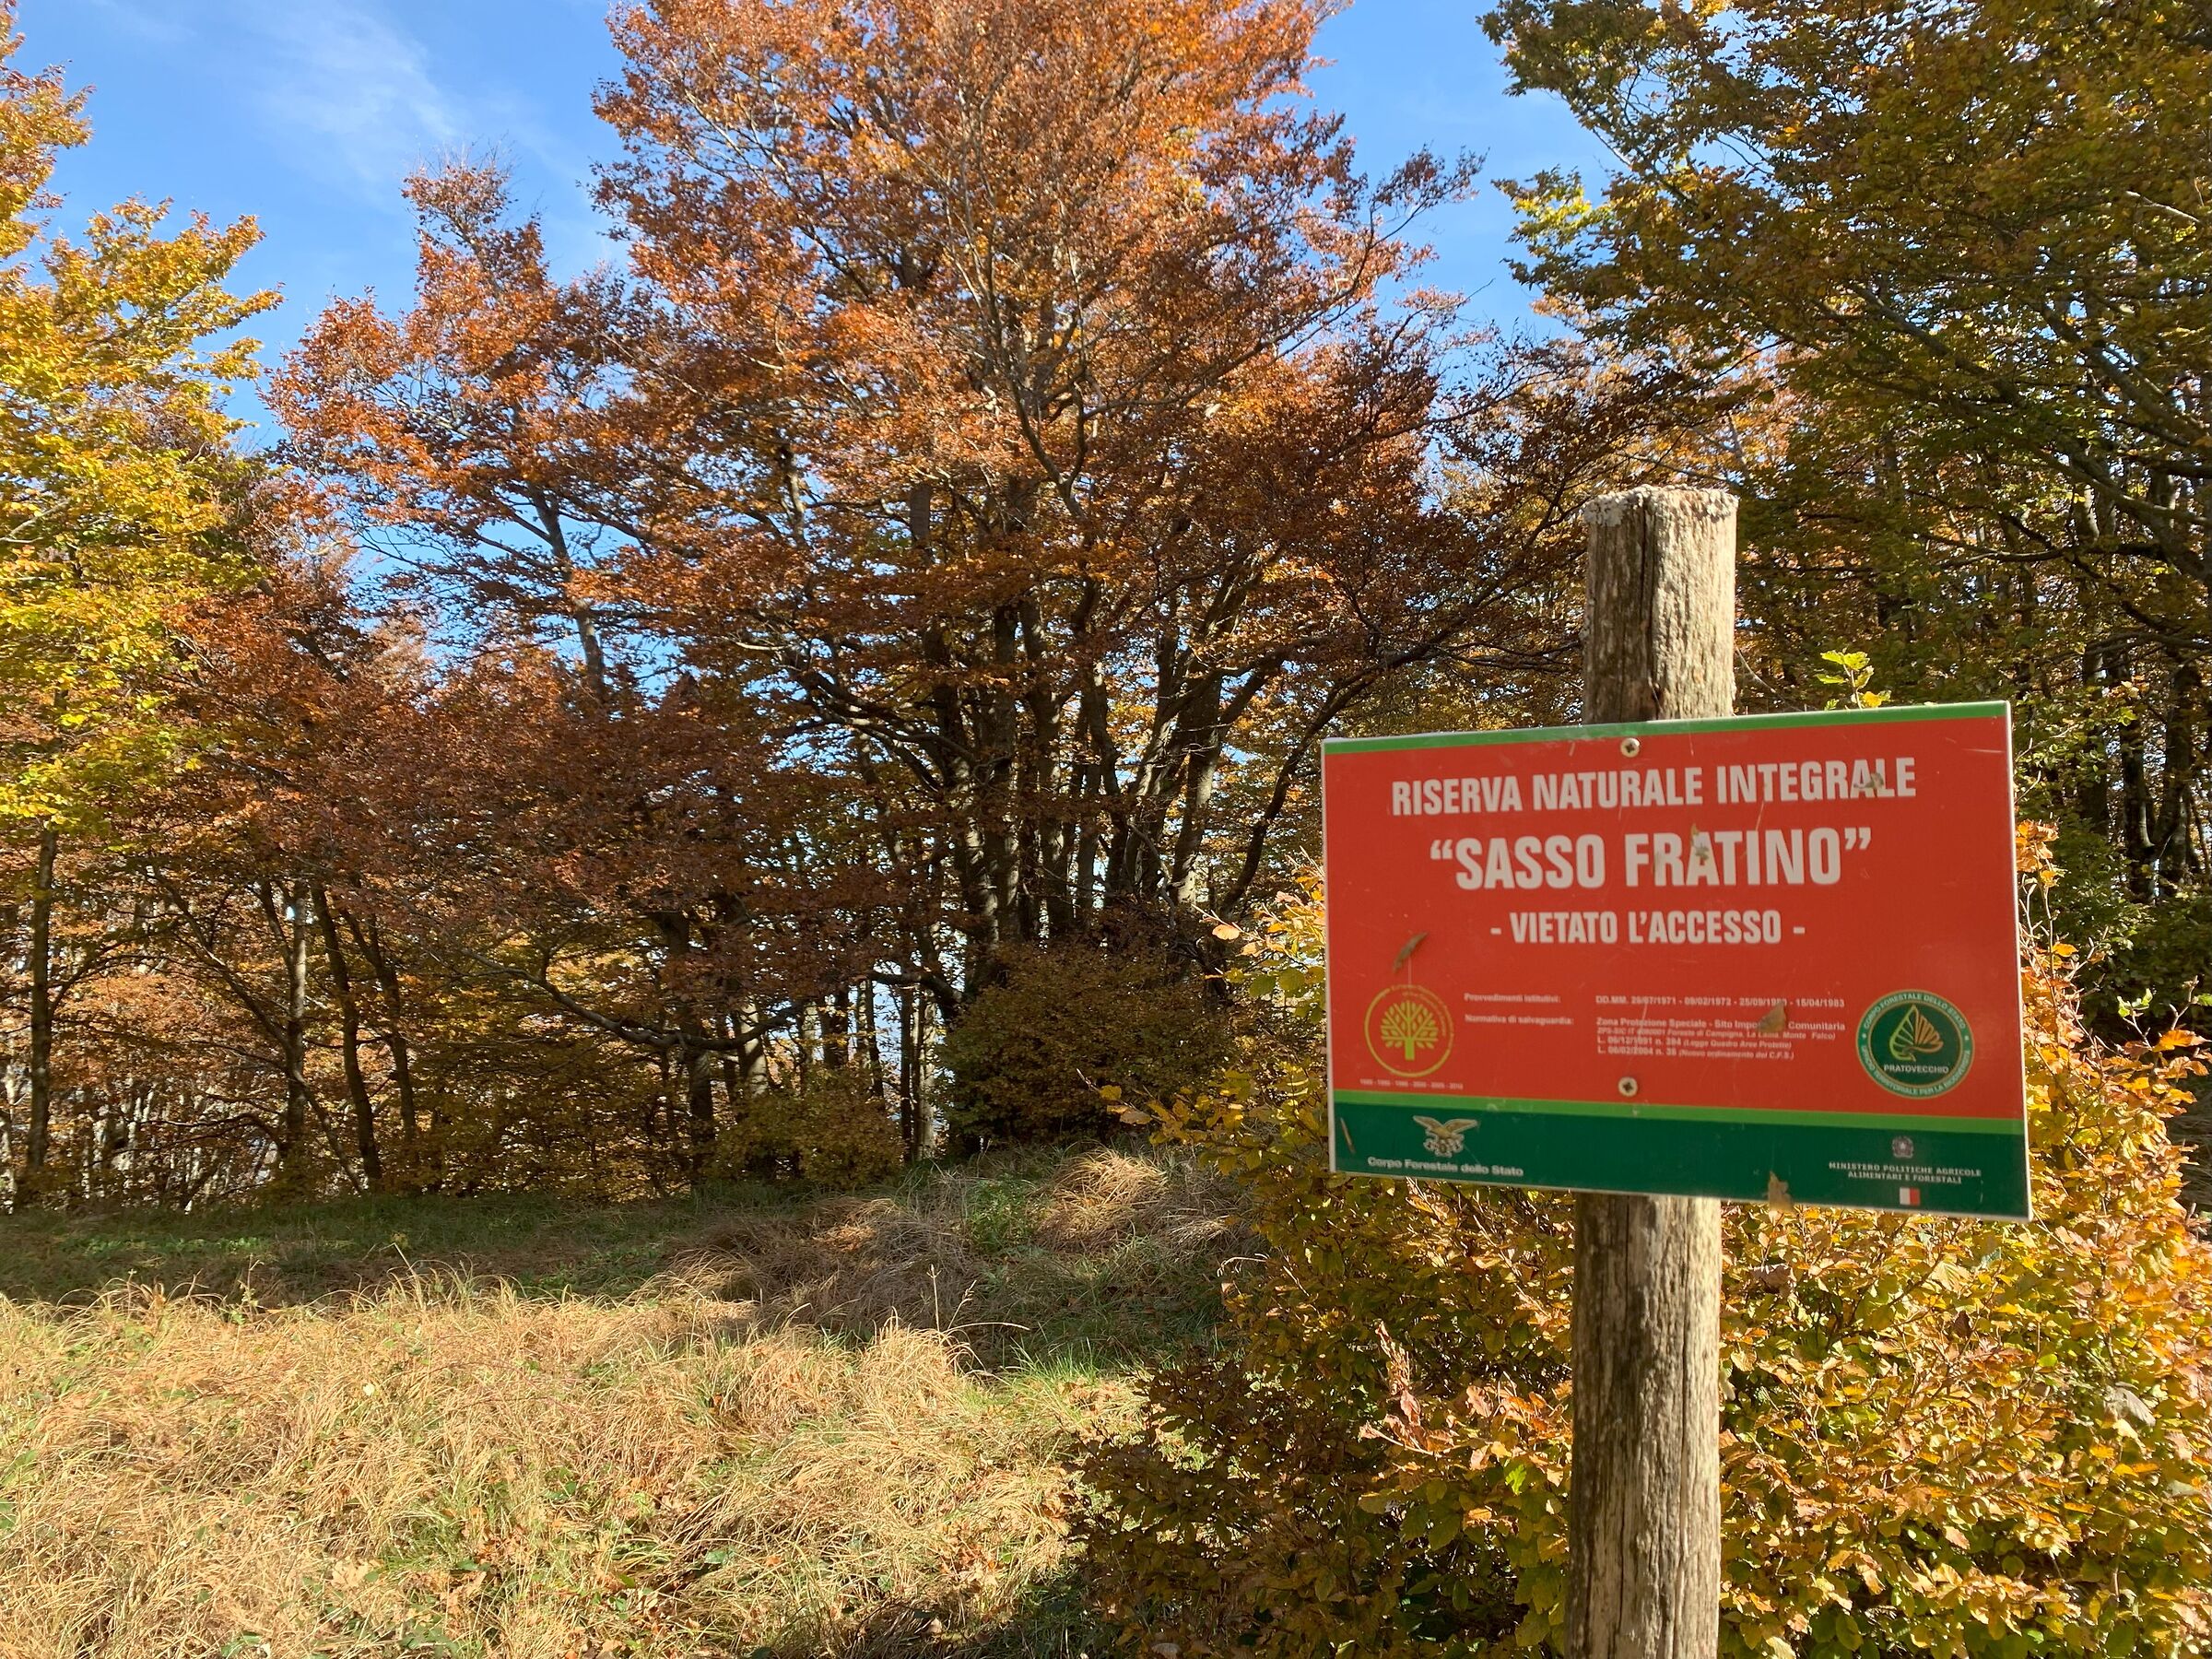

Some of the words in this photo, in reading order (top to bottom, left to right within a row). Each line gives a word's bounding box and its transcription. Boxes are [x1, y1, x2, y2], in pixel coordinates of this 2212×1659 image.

[1392, 775, 1523, 816] RISERVA
[1533, 767, 1703, 810] NATURALE
[1717, 757, 1916, 804] INTEGRALE
[1510, 912, 1618, 944] VIETATO
[1880, 993, 1923, 1009] FORESTALE
[1924, 993, 1947, 1009] DELLO
[1947, 1007, 1966, 1029] STATO
[1596, 1018, 1618, 1026] Zona
[1620, 1018, 1666, 1027] Protezione
[1669, 1018, 1706, 1029] Speciale
[1715, 1019, 1733, 1029] Sito
[1788, 1021, 1845, 1030] Comunitaria
[1883, 1064, 1949, 1074] PRATOVECCHIO
[1368, 1157, 1403, 1169] Corpo
[1404, 1159, 1458, 1172] Forestale
[1461, 1163, 1489, 1174] dello
[1491, 1165, 1524, 1177] Stato
[1829, 1161, 1880, 1171] MINISTERO
[1883, 1165, 1933, 1174] POLITICHE
[1936, 1168, 1982, 1177] AGRICOLE
[1848, 1171, 1901, 1181] ALIMENTARI
[1913, 1174, 1961, 1184] FORESTALI
